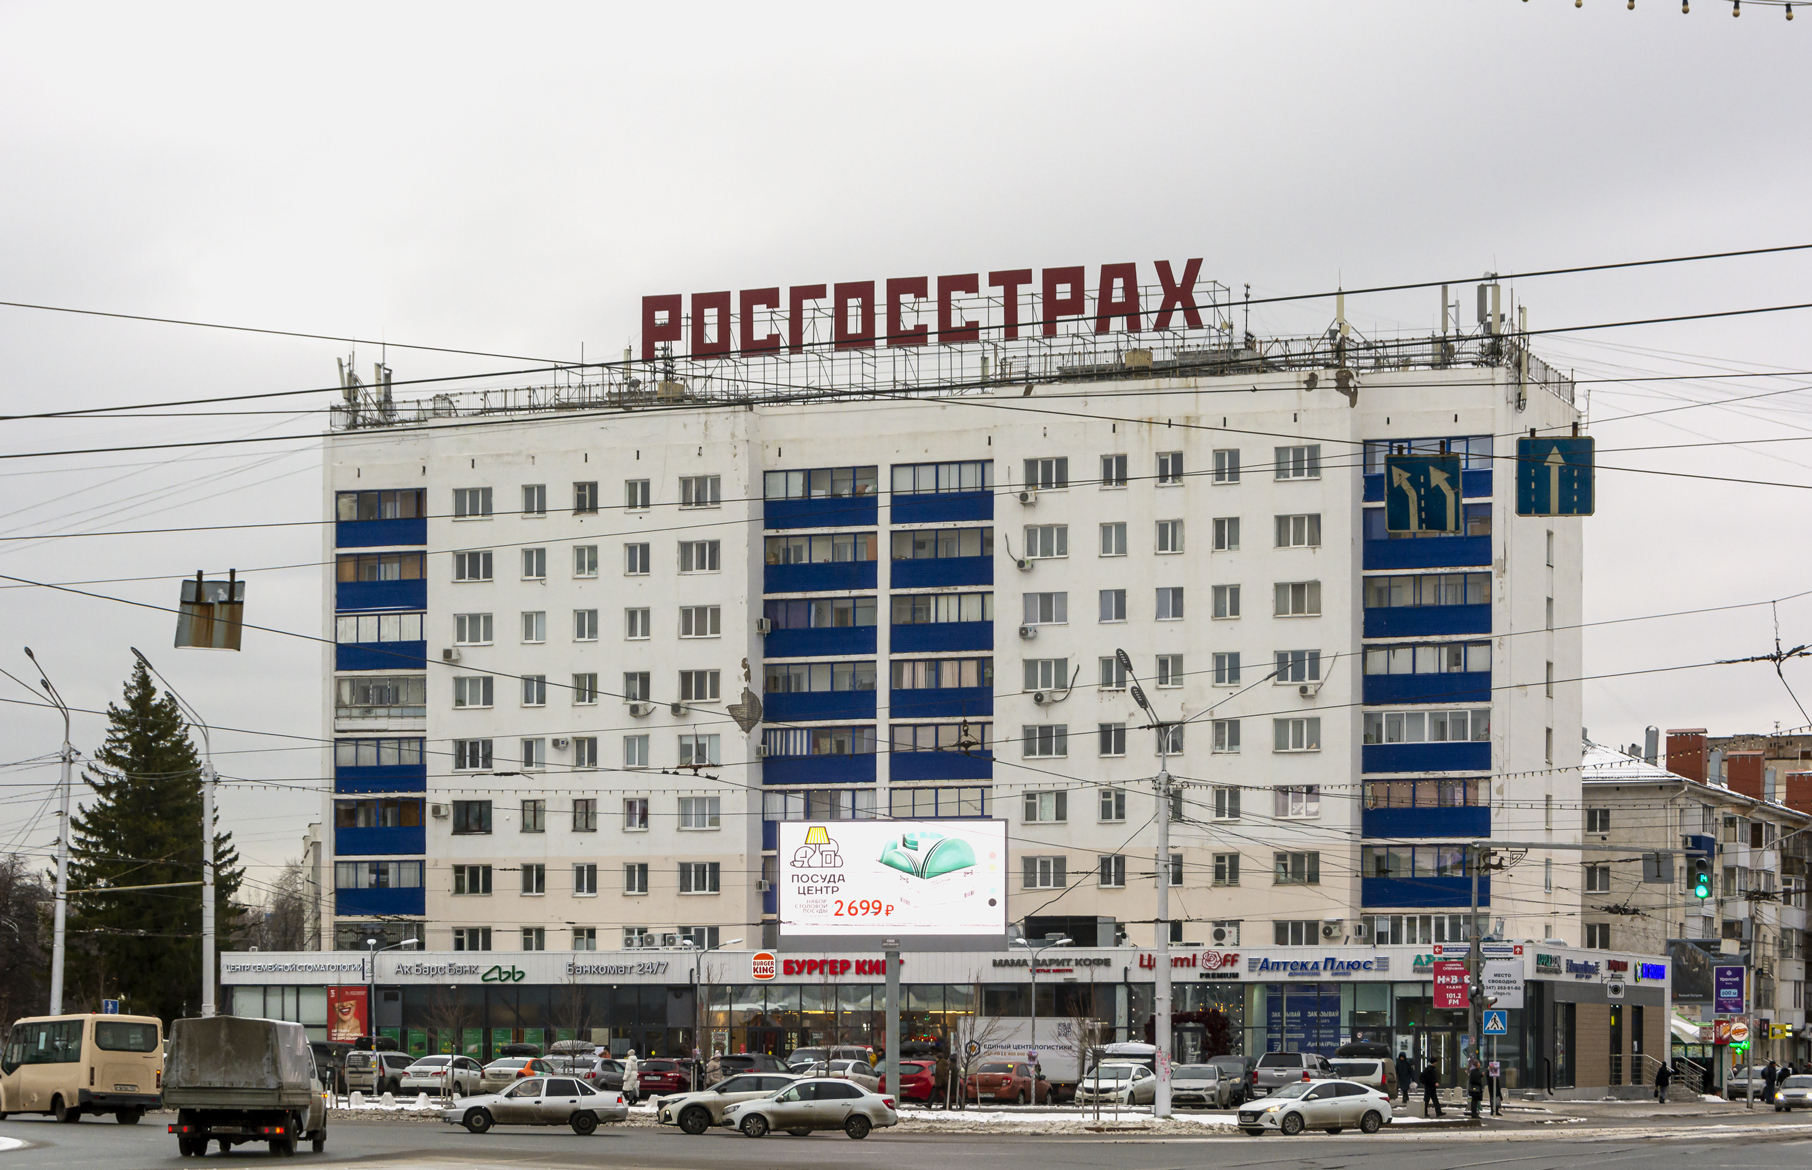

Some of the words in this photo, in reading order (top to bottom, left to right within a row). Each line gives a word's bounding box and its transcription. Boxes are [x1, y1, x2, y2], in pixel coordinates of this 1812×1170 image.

[642, 258, 1203, 362] РОСГОССТРАХ
[791, 873, 845, 884] ПОСУДА
[797, 885, 839, 896] ЦЕНТР
[226, 963, 250, 973] ЦЕНТР
[251, 963, 296, 972] СЕМЕЙНОЙ
[297, 963, 363, 973] СТОМАТОЛОГИИ
[394, 962, 412, 975] Ак
[414, 961, 446, 977] Барс
[447, 961, 480, 975] Банк
[566, 961, 635, 975] Банкомат
[636, 961, 669, 975] 24/7
[783, 958, 851, 976] БУРГЕР
[992, 958, 1029, 968] МАМА
[1075, 957, 1111, 967] КОФЕ
[1322, 957, 1373, 970] Плюс
